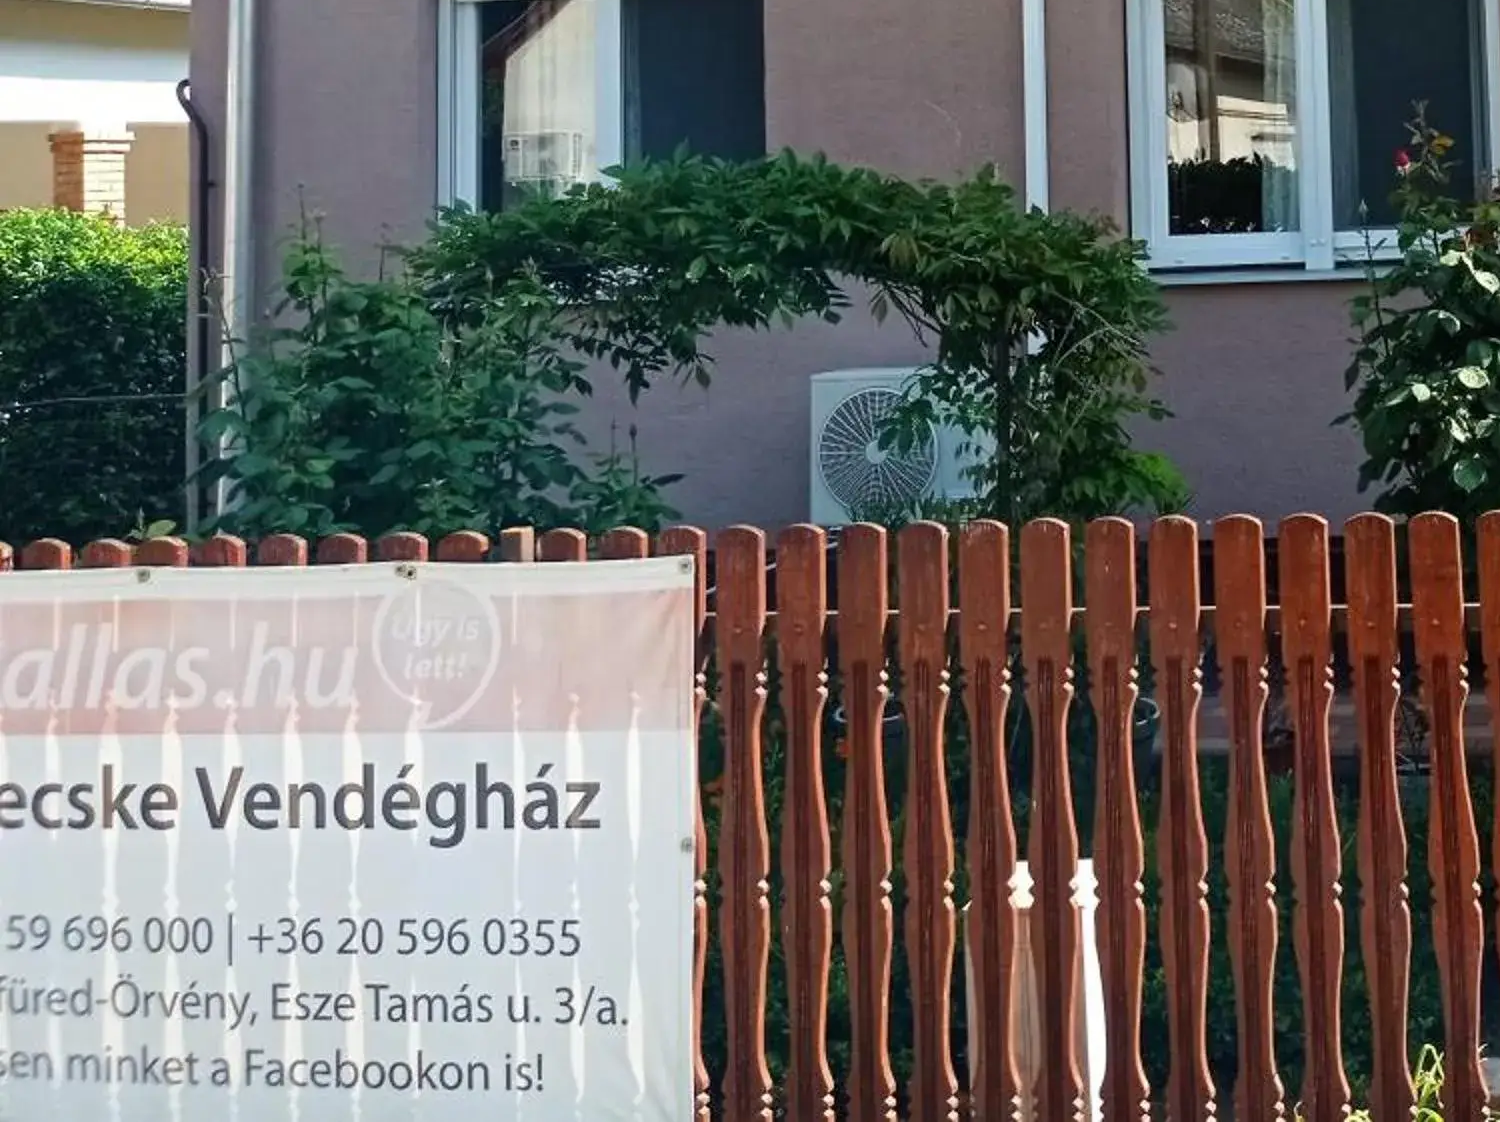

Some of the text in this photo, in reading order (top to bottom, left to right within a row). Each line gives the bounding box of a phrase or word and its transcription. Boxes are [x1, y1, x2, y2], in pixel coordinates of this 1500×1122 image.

[404, 651, 468, 681] lett!
[0, 762, 601, 848] ecske Vendégház
[6, 914, 51, 951] 59
[63, 915, 132, 952] 696
[144, 917, 213, 953] 000
[248, 917, 324, 954] +36
[336, 918, 383, 955] 20
[397, 918, 470, 955] 596
[483, 918, 581, 956] 0355
[271, 983, 355, 1021] Esze
[364, 983, 493, 1023] Tamás
[507, 995, 541, 1023] u.
[554, 985, 628, 1026] 3/a.
[67, 1045, 199, 1086] minket
[210, 1057, 230, 1086] a
[245, 1048, 490, 1091] Facebookon
[505, 1053, 544, 1091] is!
